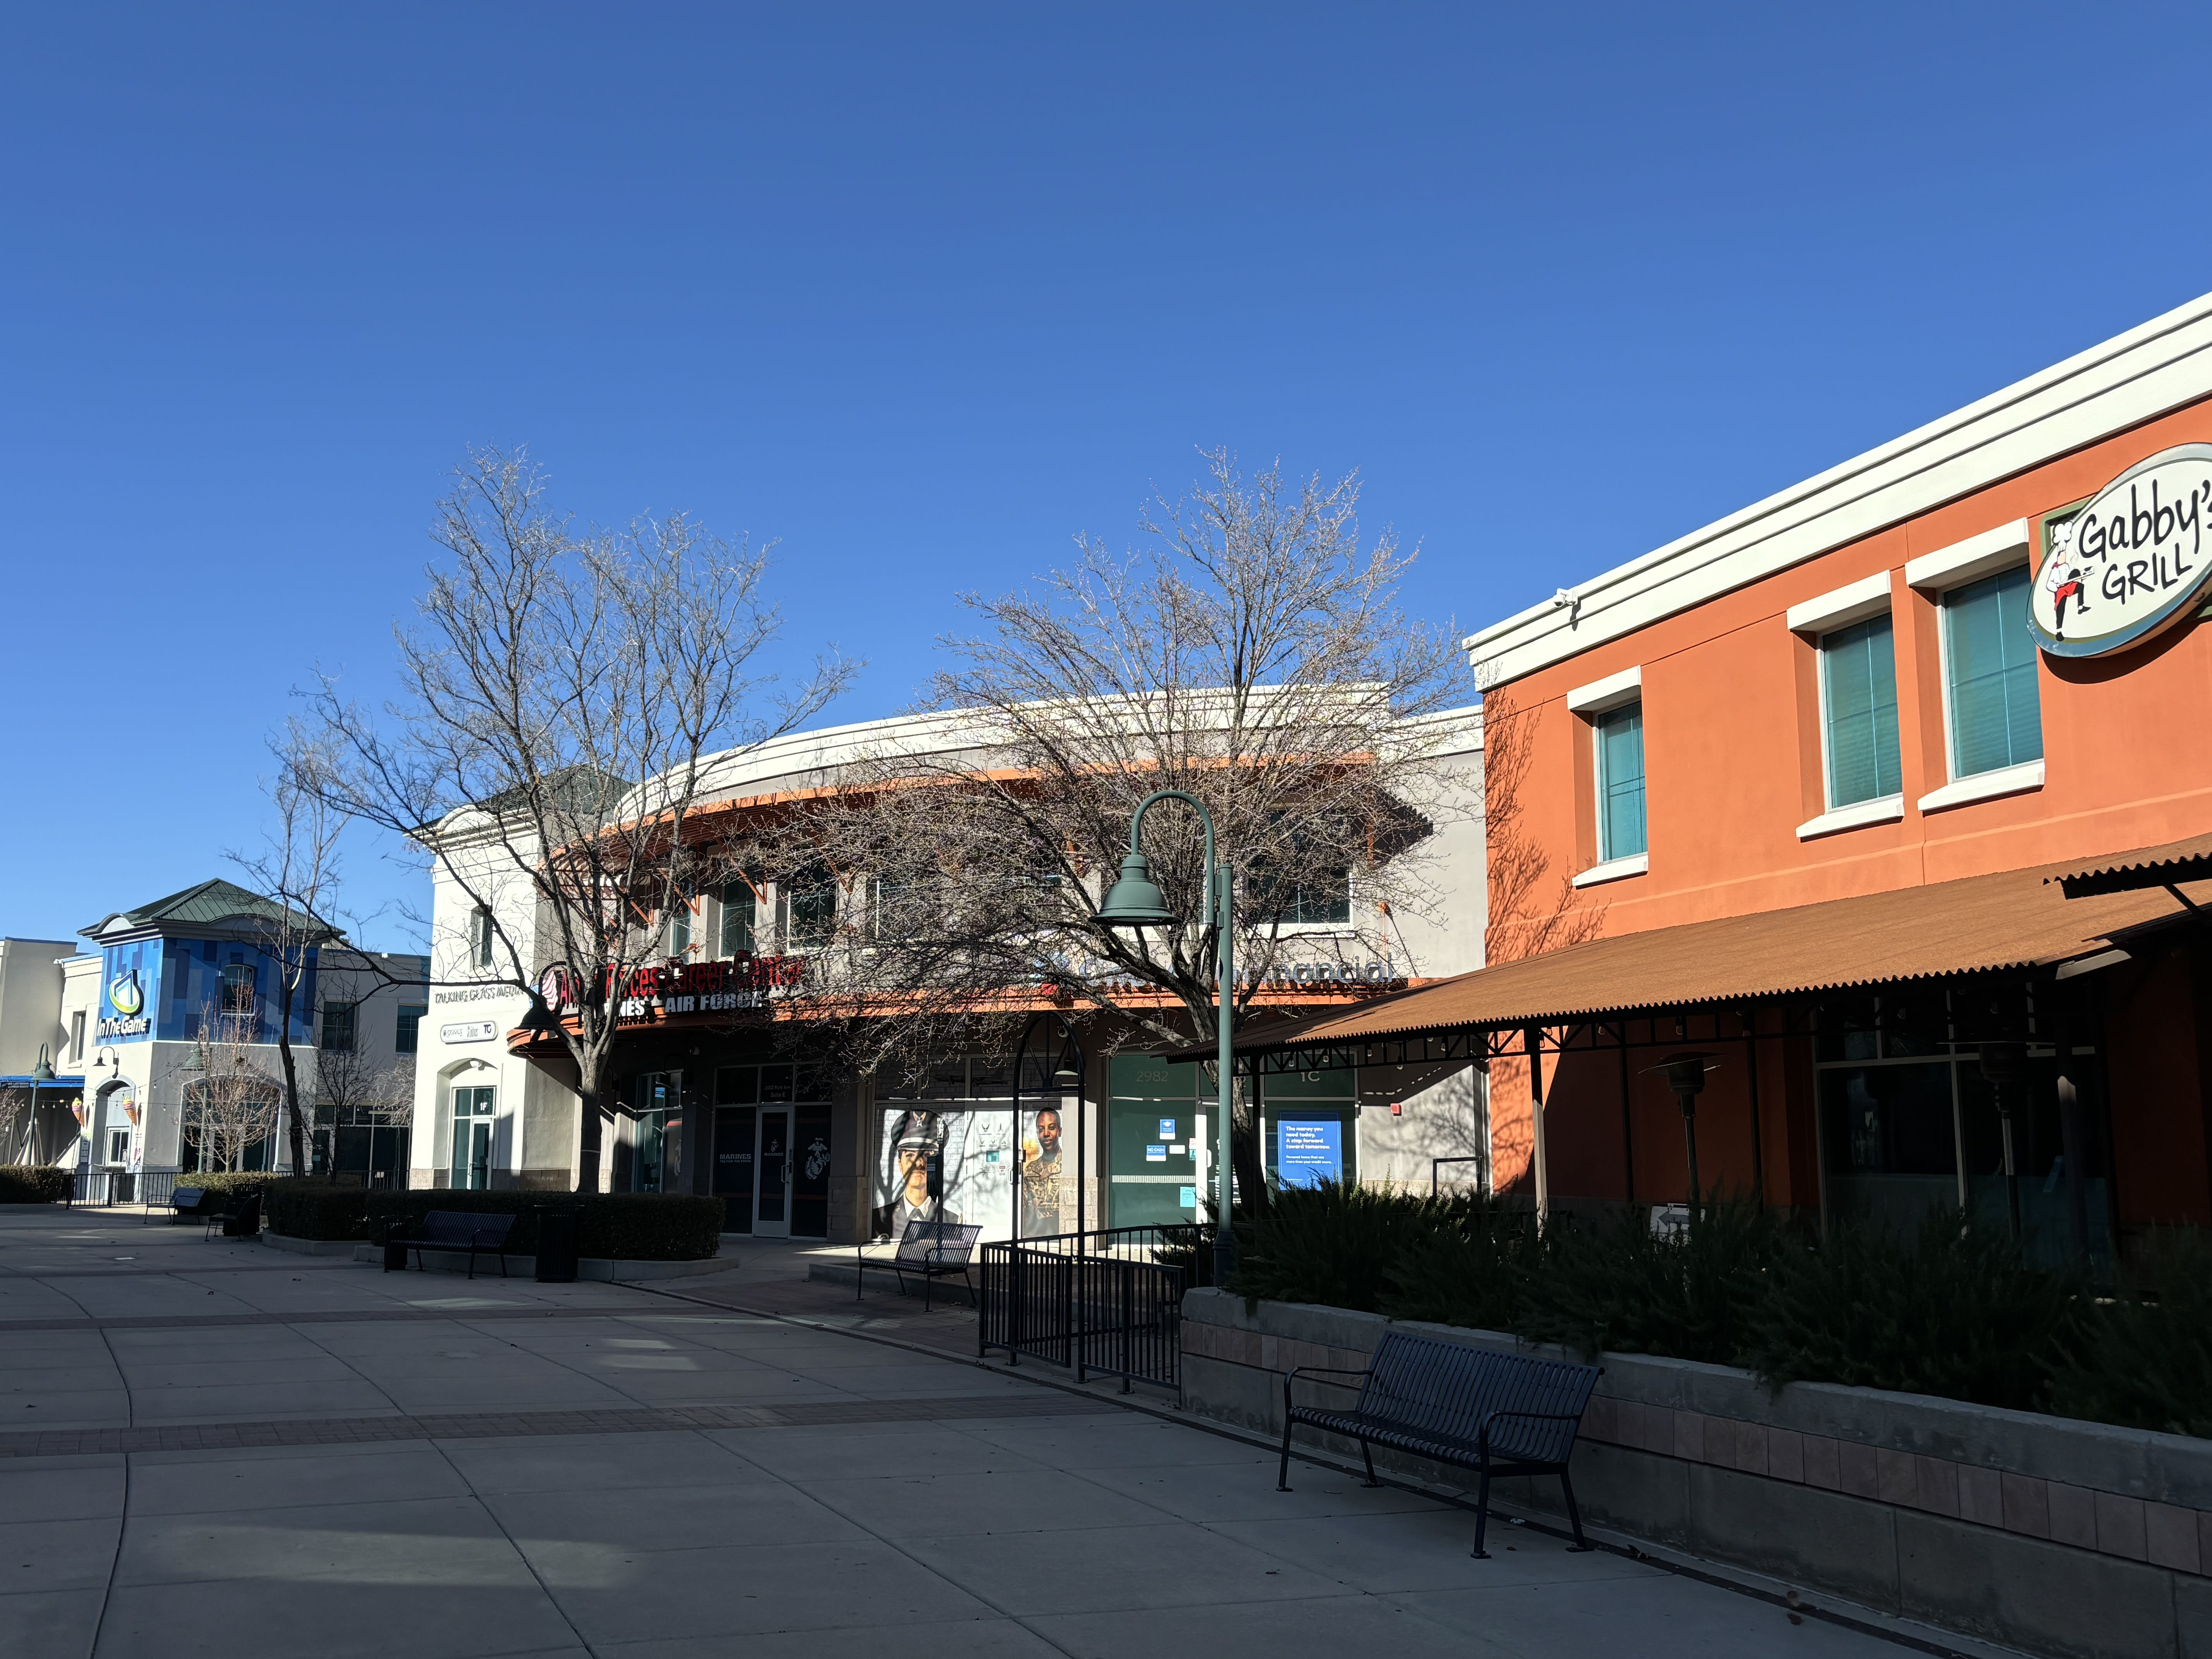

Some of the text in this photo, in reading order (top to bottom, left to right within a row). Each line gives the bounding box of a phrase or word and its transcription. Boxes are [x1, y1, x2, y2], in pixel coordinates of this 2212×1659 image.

[2102, 542, 2193, 605] GRILL
[434, 990, 469, 1004] TALKING
[469, 987, 496, 1001] GLASS
[665, 995, 695, 1013] AIR
[1137, 1071, 1168, 1082] 2982
[1300, 1071, 1320, 1082] 1C
[480, 1102, 488, 1111] 1F
